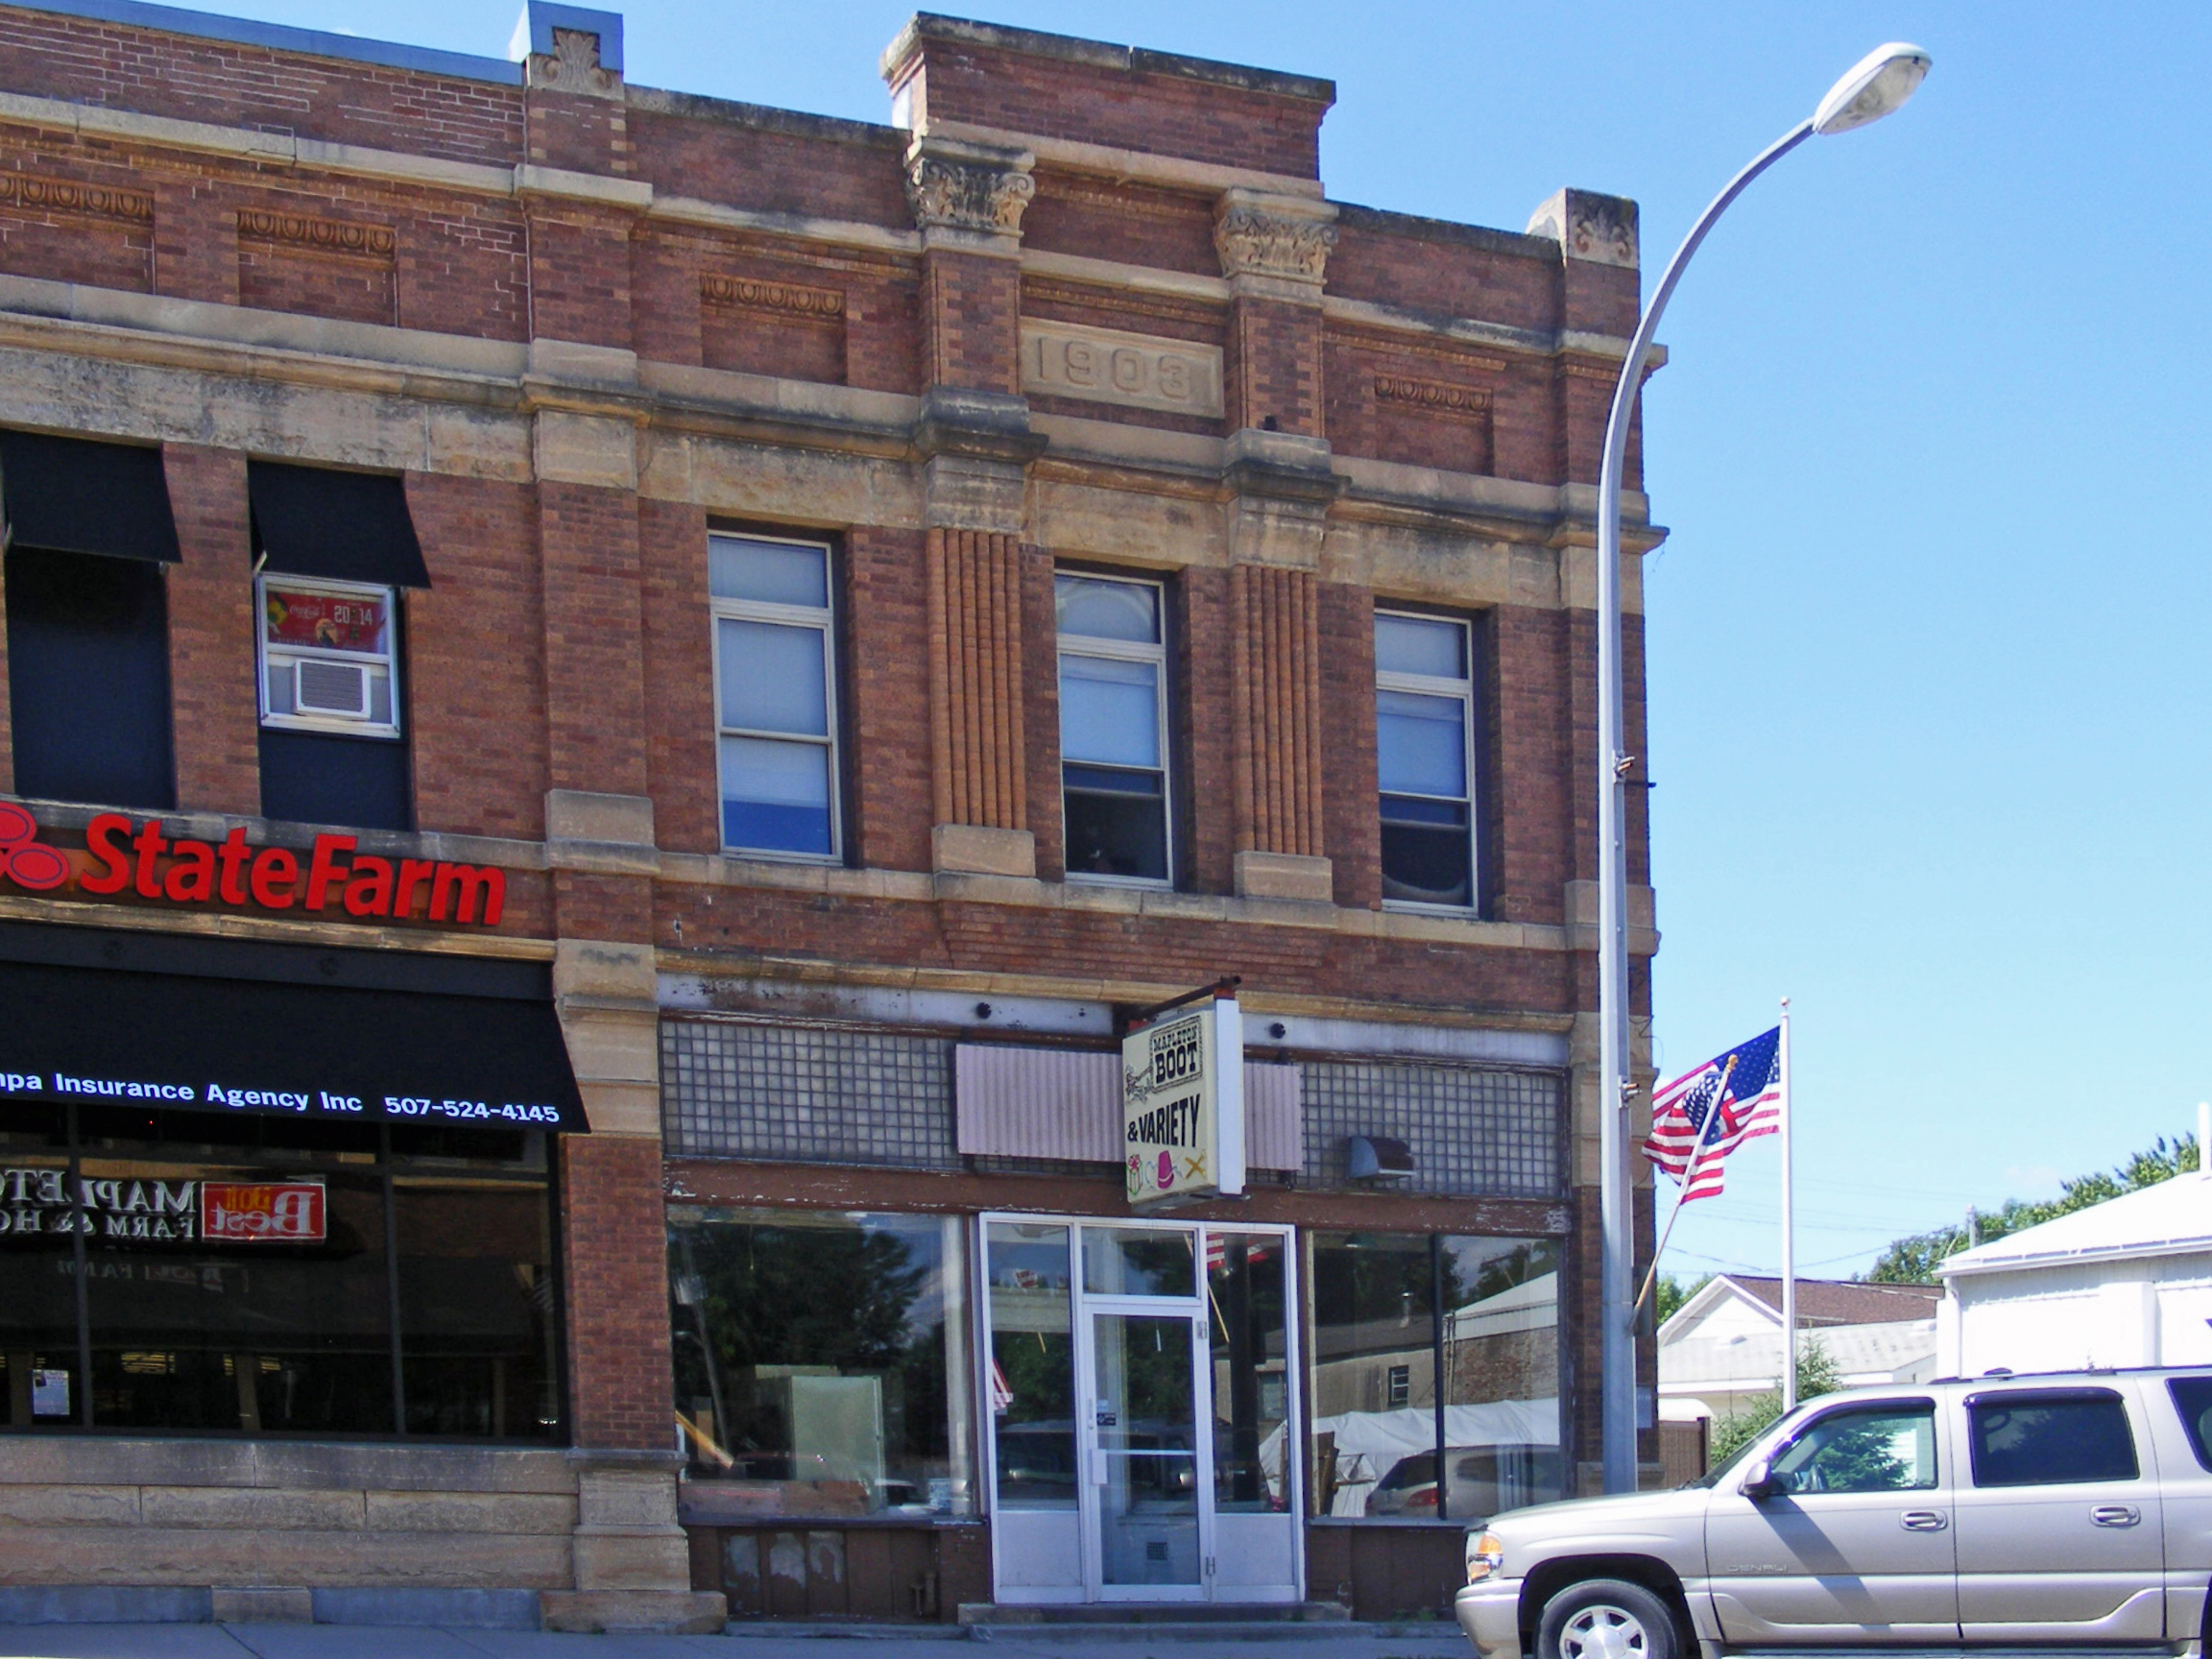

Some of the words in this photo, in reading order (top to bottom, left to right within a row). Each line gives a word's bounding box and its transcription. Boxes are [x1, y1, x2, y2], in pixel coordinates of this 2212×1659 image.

[1036, 337, 1191, 400] 1903
[1153, 1025, 1198, 1052] MAPLETON
[1154, 1041, 1198, 1085] BOOT
[55, 1072, 195, 1101] Insurance
[206, 1083, 309, 1112] Agency
[320, 1091, 364, 1112] Inc
[384, 1096, 560, 1123] 507-524-4145
